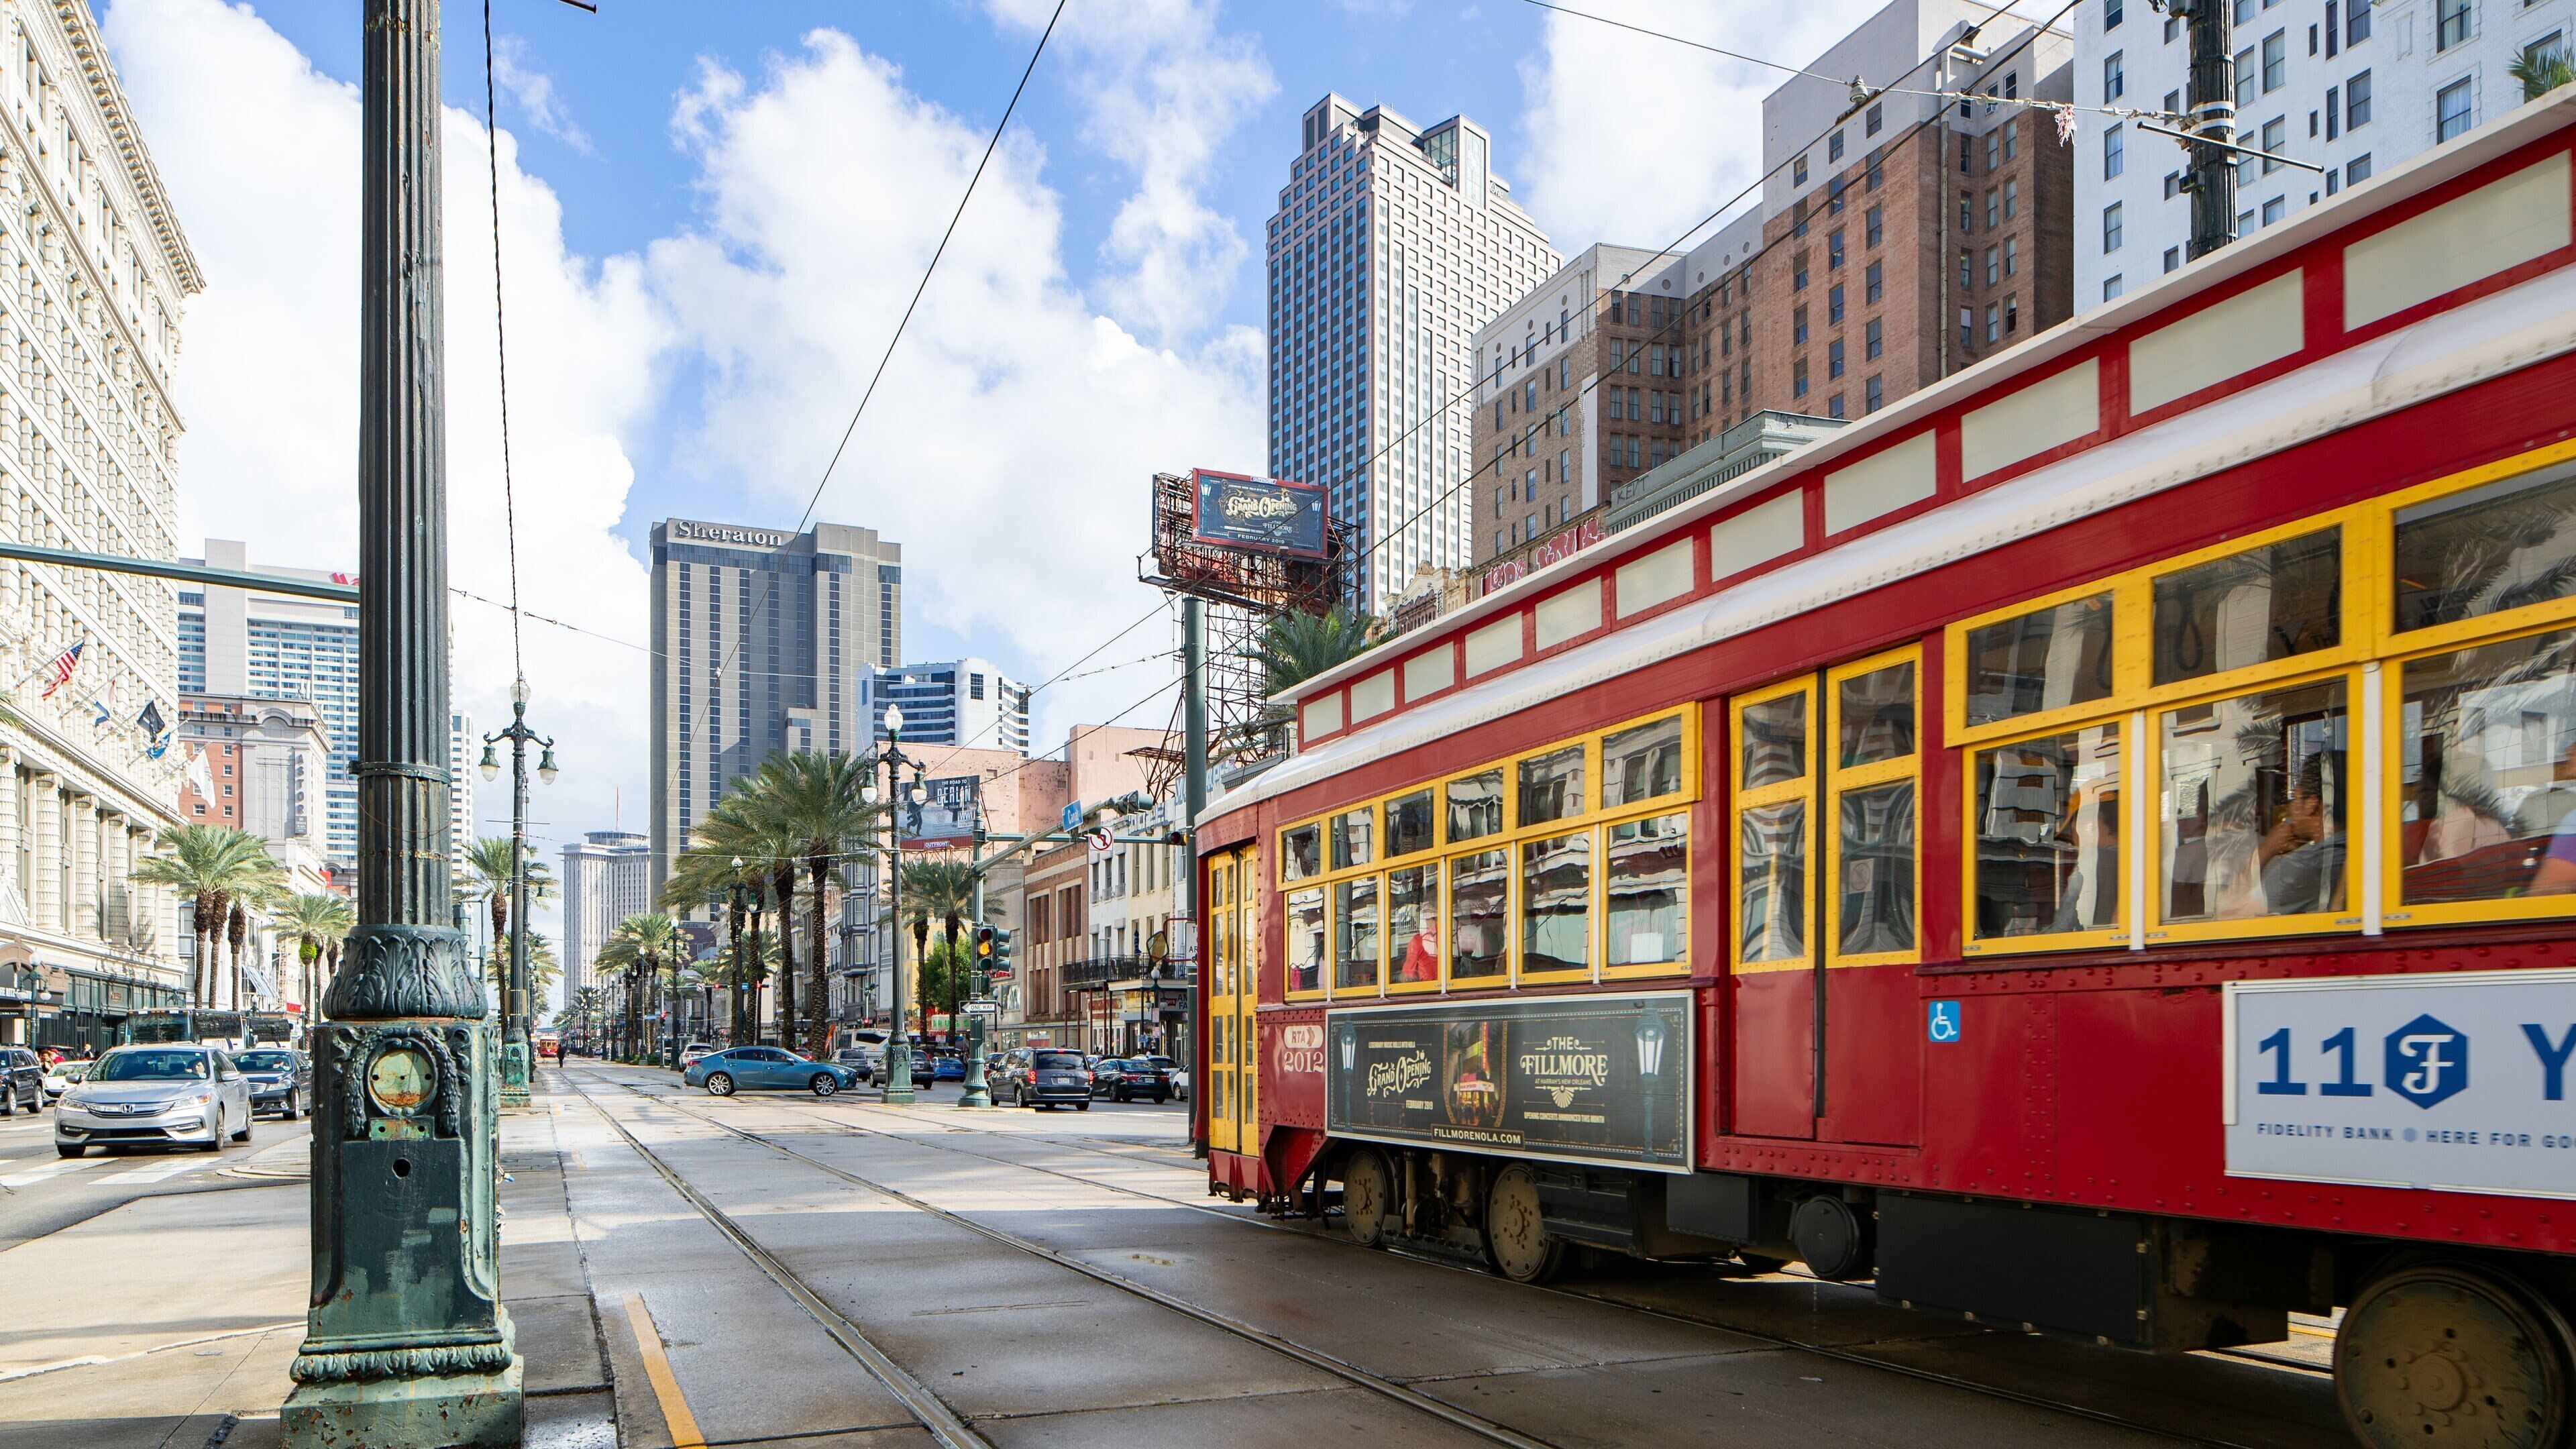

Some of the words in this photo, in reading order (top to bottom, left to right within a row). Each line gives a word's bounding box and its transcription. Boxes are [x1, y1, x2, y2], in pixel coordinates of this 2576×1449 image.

[1490, 182, 1504, 198] One
[1226, 496, 1260, 519] GRAND
[1258, 496, 1298, 519] OPENING
[678, 521, 783, 546] Sheraton
[1263, 523, 1293, 534] FILLMORE
[1238, 534, 1270, 543] FEBRUARY
[295, 753, 305, 815] ASTOR
[959, 810, 975, 820] WWII
[1067, 808, 1079, 824] Canal
[1291, 1030, 1305, 1043] RTA
[1552, 1036, 1574, 1051] THE
[1284, 1051, 1324, 1073] 2012
[1367, 1063, 1395, 1097] GRAND
[1395, 1053, 1432, 1094] OPENING
[1519, 1054, 1609, 1087] FILLMORE
[1405, 1099, 1424, 1109] FEBRUARY
[1424, 1100, 1433, 1110] 2019
[1434, 1128, 1521, 1144] FILLMORENOLA.COM
[2257, 1122, 2335, 1138] FIDELITY
[2343, 1126, 2394, 1142] BANK
[2426, 1129, 2480, 1146] HERE
[2489, 1132, 2532, 1148] FOR
[2542, 1134, 2576, 1149] GO
